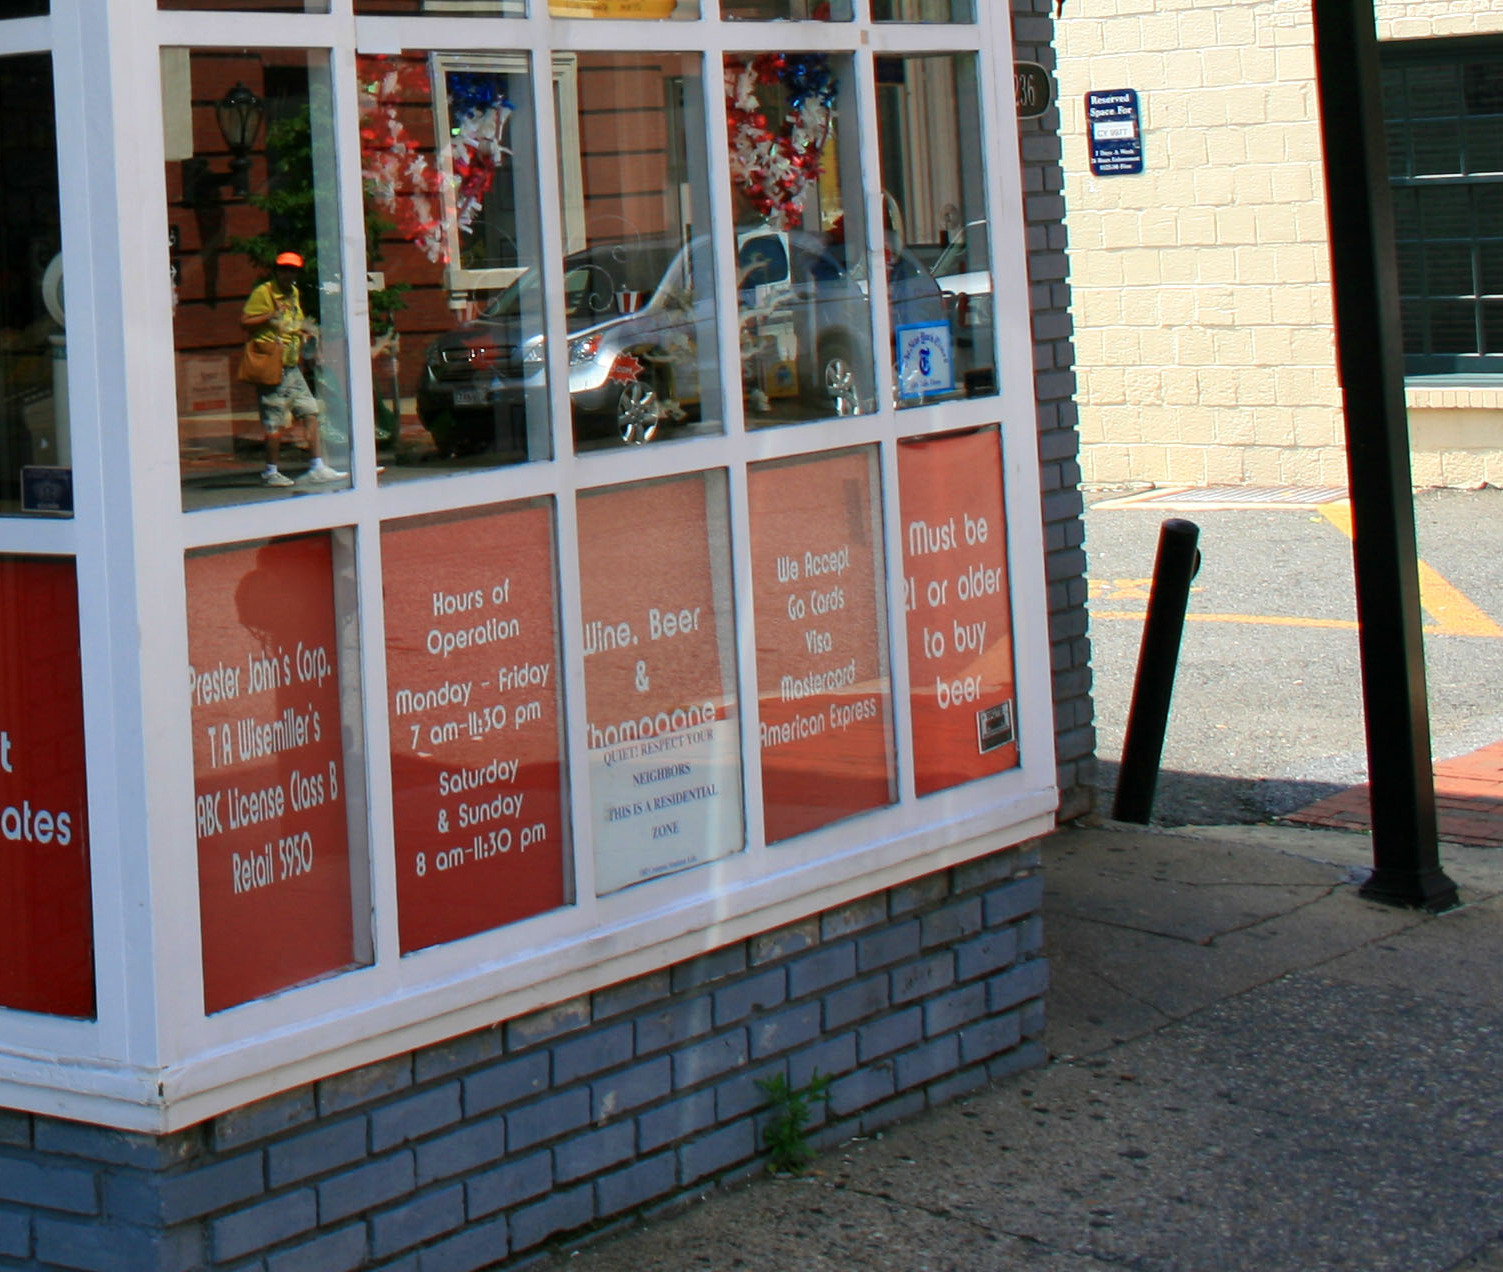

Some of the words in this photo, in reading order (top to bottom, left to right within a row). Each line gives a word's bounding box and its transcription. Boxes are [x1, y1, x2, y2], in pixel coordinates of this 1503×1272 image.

[1091, 94, 1129, 104] Reserved
[1117, 106, 1133, 115] For
[909, 517, 957, 556] Must
[964, 513, 988, 545] be
[777, 556, 799, 583] We
[805, 545, 850, 578] Accept
[433, 588, 484, 616] Hours
[492, 578, 509, 604] of
[787, 593, 805, 621] Go
[811, 585, 845, 616] Cards
[927, 579, 948, 607] or
[957, 563, 1002, 600] older
[427, 618, 520, 658] Operation
[649, 607, 700, 640] Beer
[805, 629, 832, 655] Visa
[923, 627, 945, 659] to
[953, 619, 986, 655] buy
[187, 660, 240, 706] Prester
[248, 646, 291, 695] John's
[296, 641, 331, 688] Corp.
[395, 681, 472, 716] Monday
[499, 662, 549, 692] Friday
[635, 660, 649, 693] &
[780, 658, 856, 703] Mastercard
[936, 675, 982, 709] beer
[237, 703, 321, 762] Wisemiller's
[410, 724, 421, 750] 7
[515, 700, 541, 729] pm
[760, 712, 825, 748] American
[830, 697, 876, 731] Express
[603, 745, 638, 767] QUIET!
[641, 736, 684, 756] RESPECT
[685, 729, 713, 745] YOUR
[439, 758, 519, 796] Saturday
[633, 762, 691, 786] NEIGHBORS
[197, 790, 223, 839] ABC
[227, 784, 285, 830] License
[290, 769, 324, 813] Class
[329, 760, 338, 801] B
[437, 808, 449, 834] &
[459, 792, 523, 828] Sunday
[608, 806, 631, 822] THIS
[633, 802, 643, 816] IS
[646, 801, 651, 812] A
[653, 784, 718, 809] RESIDENTIAL
[416, 852, 427, 877] 8
[520, 822, 547, 852] pm
[652, 821, 679, 840] ZONE
[232, 842, 273, 894] Retail
[279, 831, 313, 880] 5950
